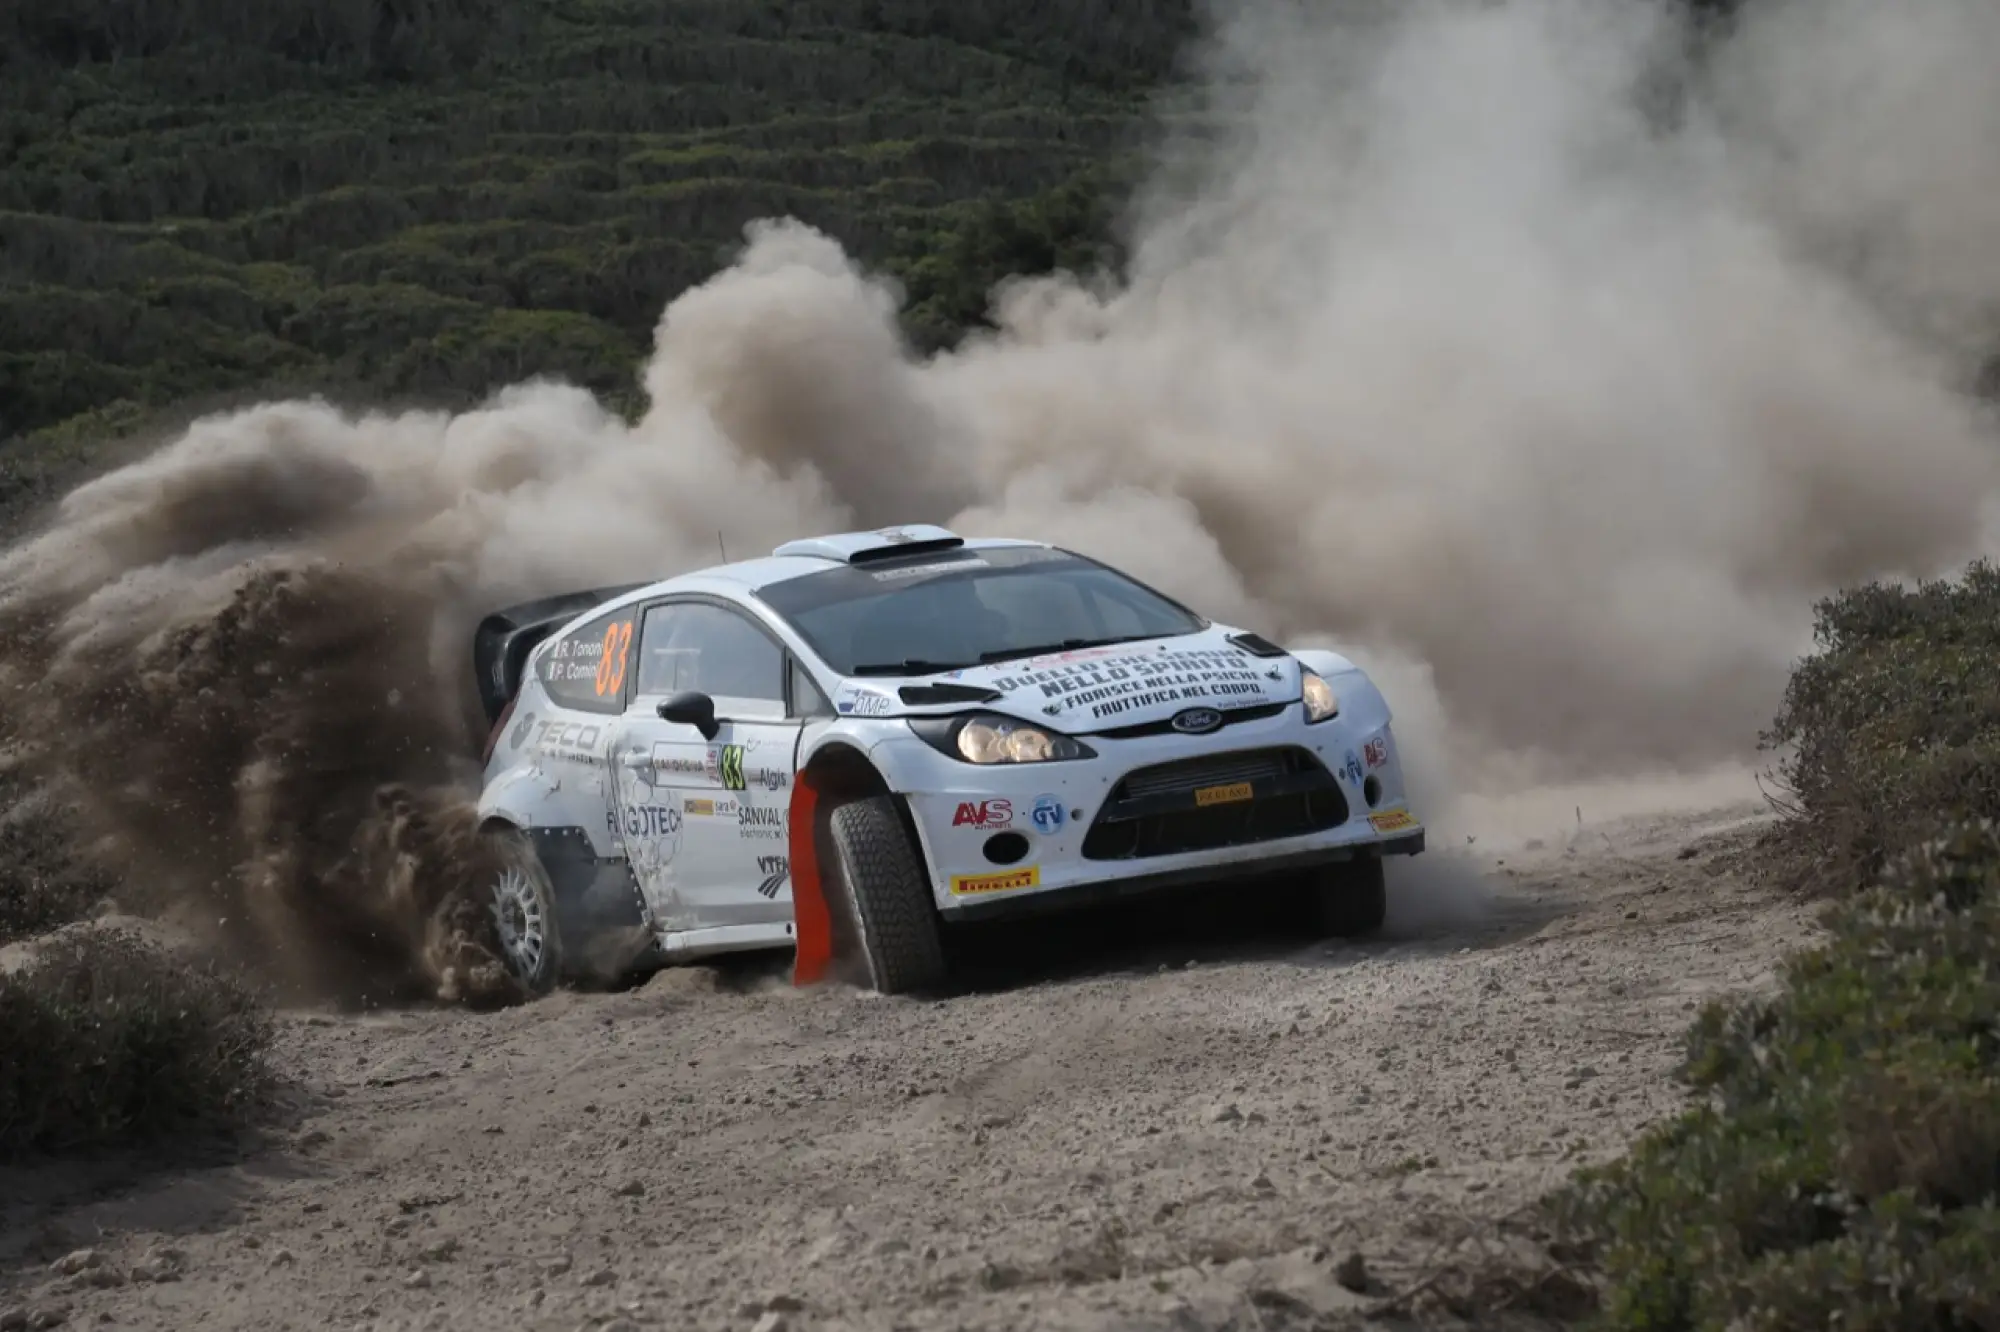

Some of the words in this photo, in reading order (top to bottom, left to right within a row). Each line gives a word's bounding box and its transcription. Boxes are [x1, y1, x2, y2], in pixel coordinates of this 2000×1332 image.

[596, 622, 632, 696] 83
[1039, 668, 1130, 699] NELLO
[1066, 681, 1143, 709] FIORISCE
[1144, 672, 1199, 689] NELLA
[1091, 689, 1179, 718] FRUTTIFICA
[1181, 686, 1209, 698] NEL
[724, 744, 745, 790] 83
[760, 768, 787, 790] Algis
[738, 807, 781, 826] SANVAL
[952, 799, 1013, 826] AVS
